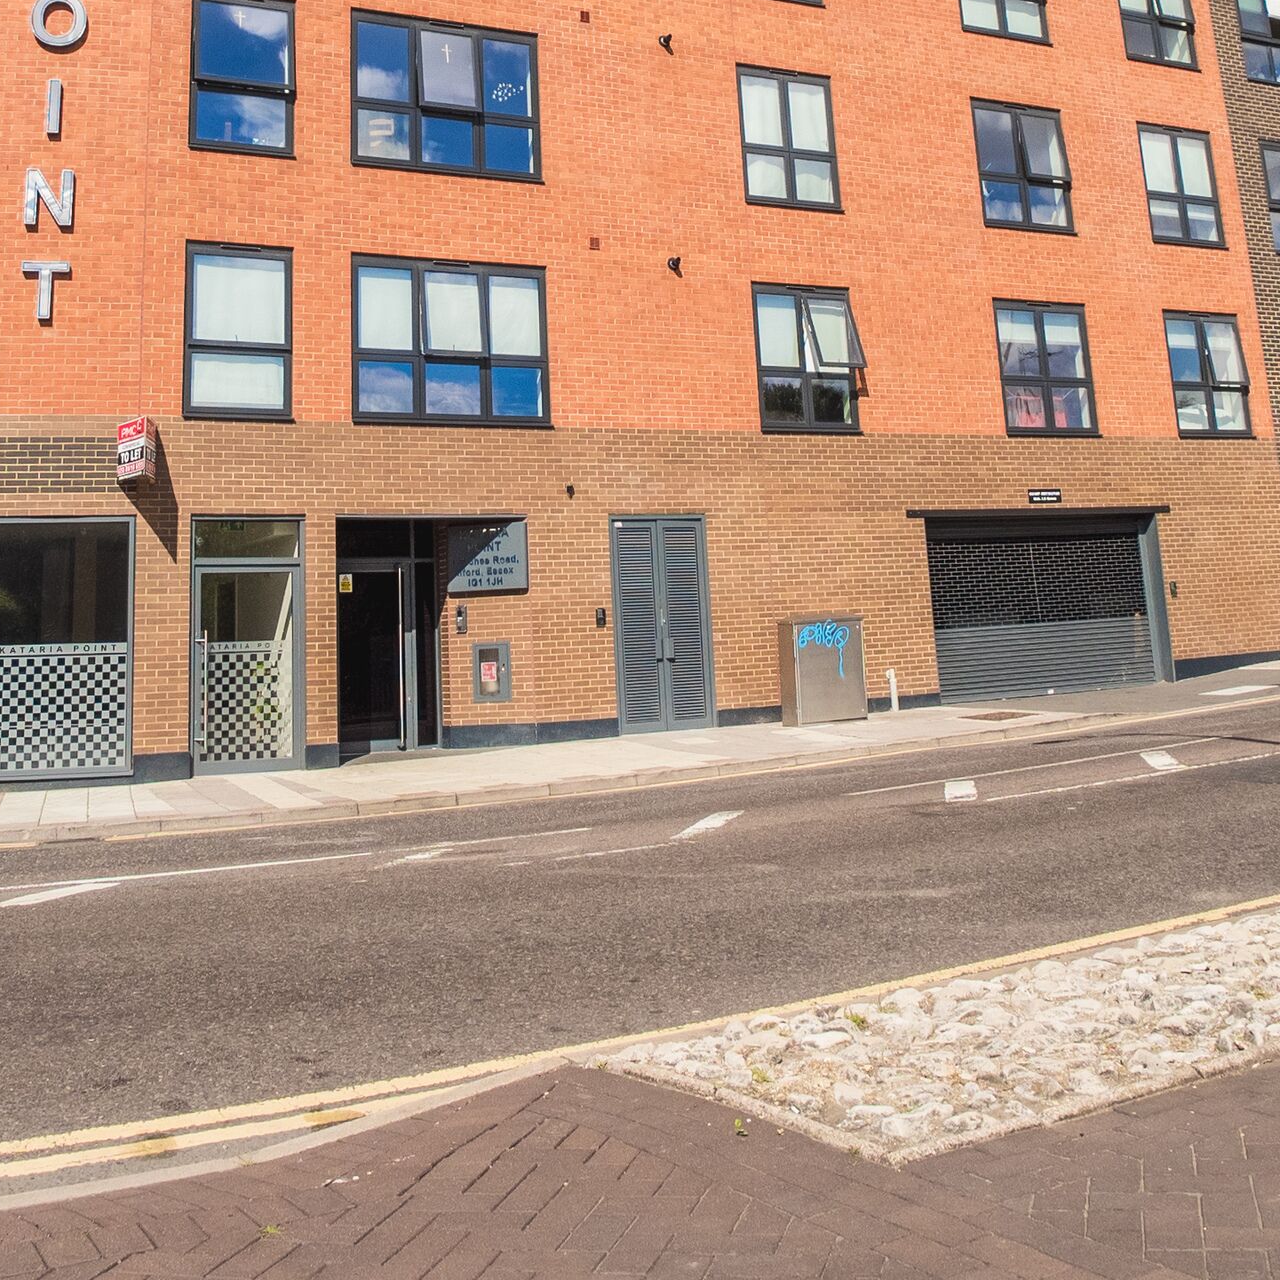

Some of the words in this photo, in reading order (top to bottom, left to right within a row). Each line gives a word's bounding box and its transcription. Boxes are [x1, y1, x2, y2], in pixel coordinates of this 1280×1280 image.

[120, 451, 130, 464] TO
[130, 447, 142, 460] LET
[486, 577, 503, 586] 1JH
[0, 646, 64, 654] KATARIA
[73, 644, 117, 652] POINT
